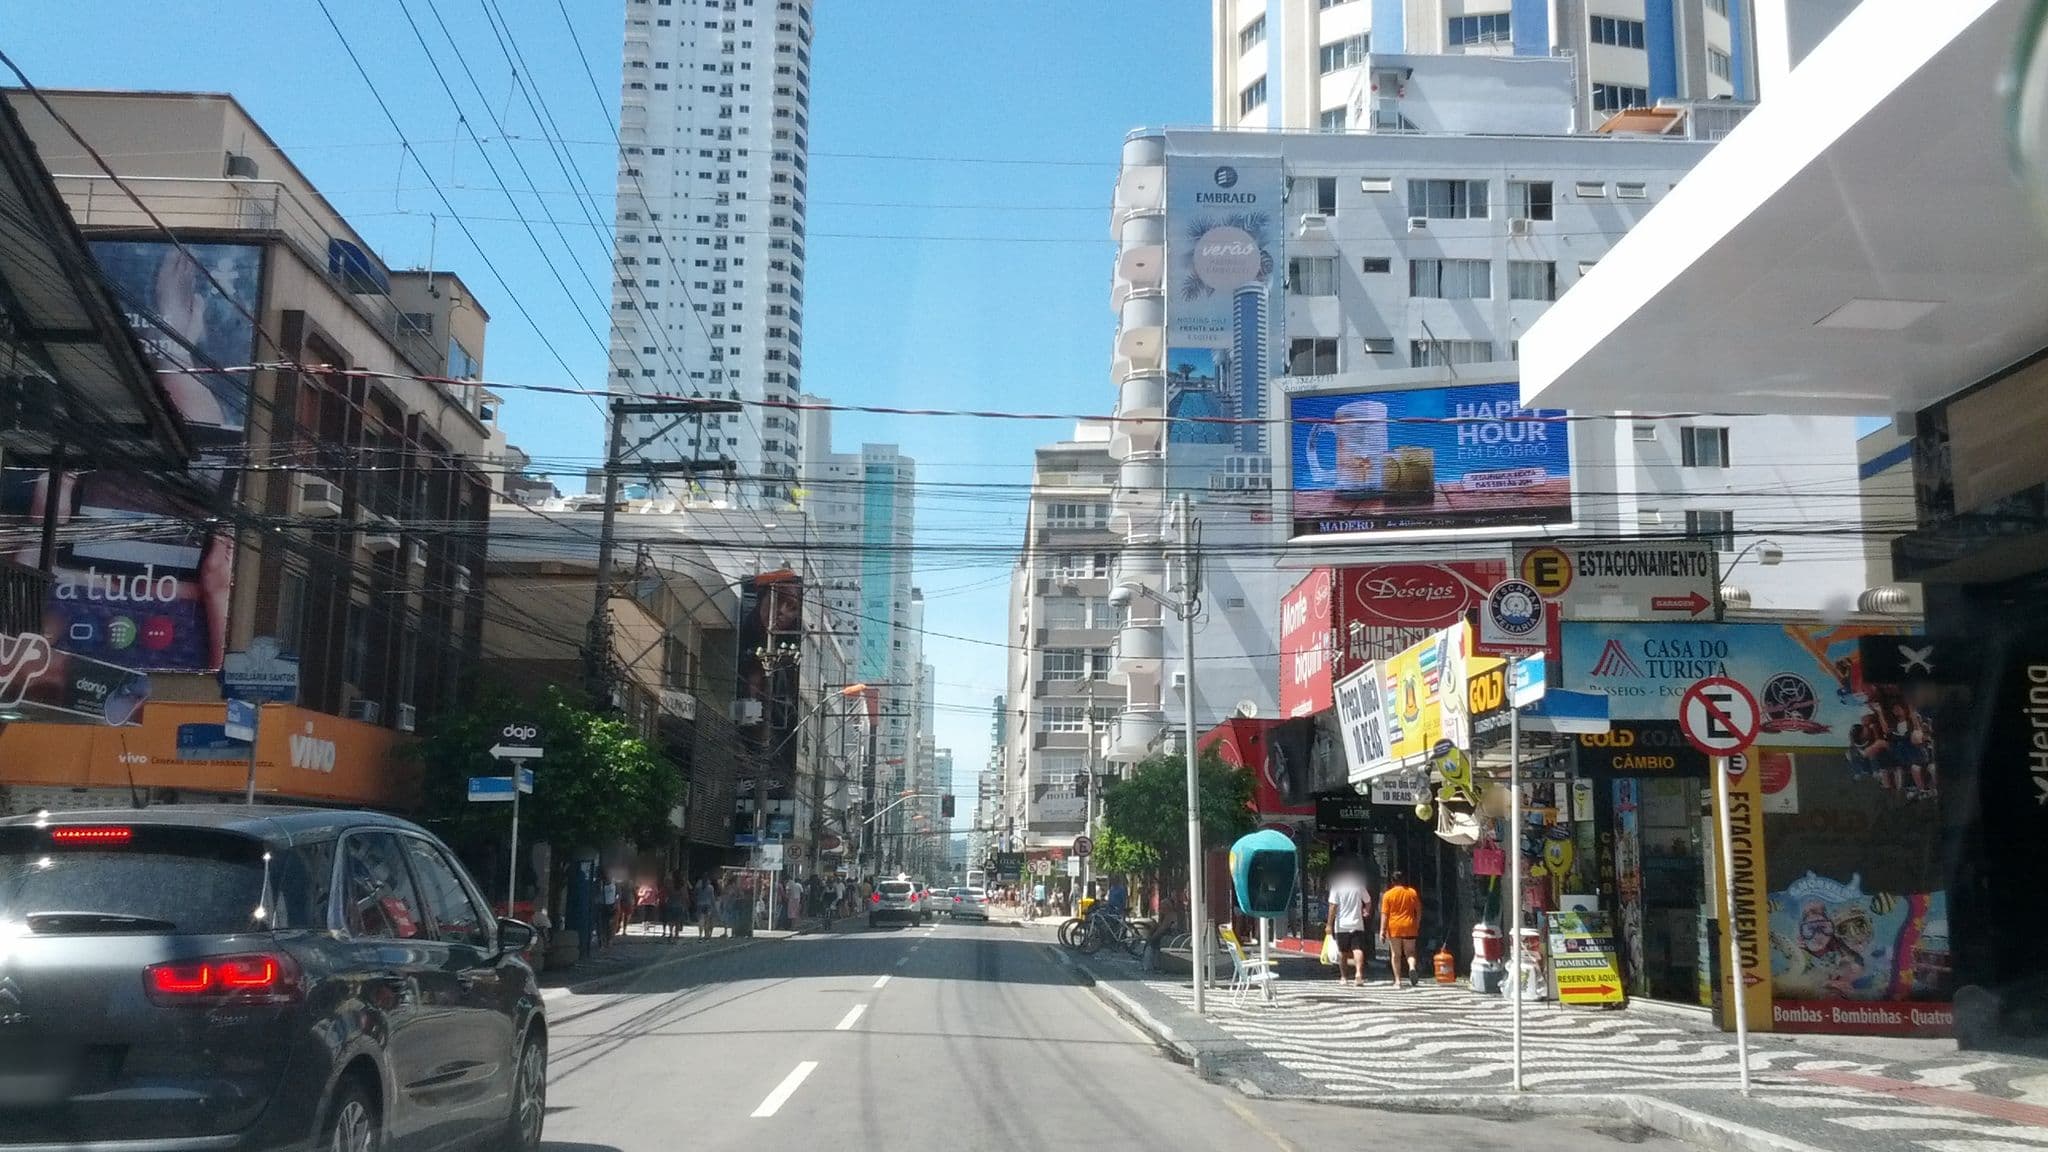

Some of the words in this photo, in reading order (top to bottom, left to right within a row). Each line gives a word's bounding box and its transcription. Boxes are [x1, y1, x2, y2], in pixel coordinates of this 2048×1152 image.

[1196, 193, 1257, 204] EMBRAED
[1457, 421, 1548, 445] HOUR
[1457, 446, 1482, 459] EM
[1487, 442, 1548, 458] DOBRO
[1319, 521, 1374, 532] MADERO
[1533, 557, 1561, 587] E
[1577, 549, 1709, 578] ESTACIONAMENTO
[86, 564, 177, 602] tudo
[1365, 577, 1455, 600] Desejos
[1492, 584, 1540, 611] PESCAMAR
[1282, 590, 1308, 638] Monte
[1496, 614, 1537, 633] PEIXARIA
[1643, 639, 1698, 659] CASA
[1700, 639, 1729, 659] DO
[1645, 660, 1728, 679] TURISTA
[1469, 671, 1503, 714] GOLD
[2022, 664, 2048, 771] Hering
[287, 720, 337, 774] vivo
[1360, 717, 1384, 761] REAIS
[1580, 728, 1635, 747] GOLD
[118, 752, 149, 766] vivo
[1611, 754, 1676, 769] CÂMBIO
[1382, 791, 1391, 801] 10
[1392, 791, 1412, 802] REAIS
[1728, 791, 1759, 968] ESTACIONAMENTO
[1556, 958, 1608, 968] BOMBINHAS
[1558, 975, 1597, 983] RESERVAS
[1774, 1005, 1823, 1023] Bombas
[1832, 1006, 1901, 1025] Bombinhas
[1911, 1008, 1953, 1026] Quatro
